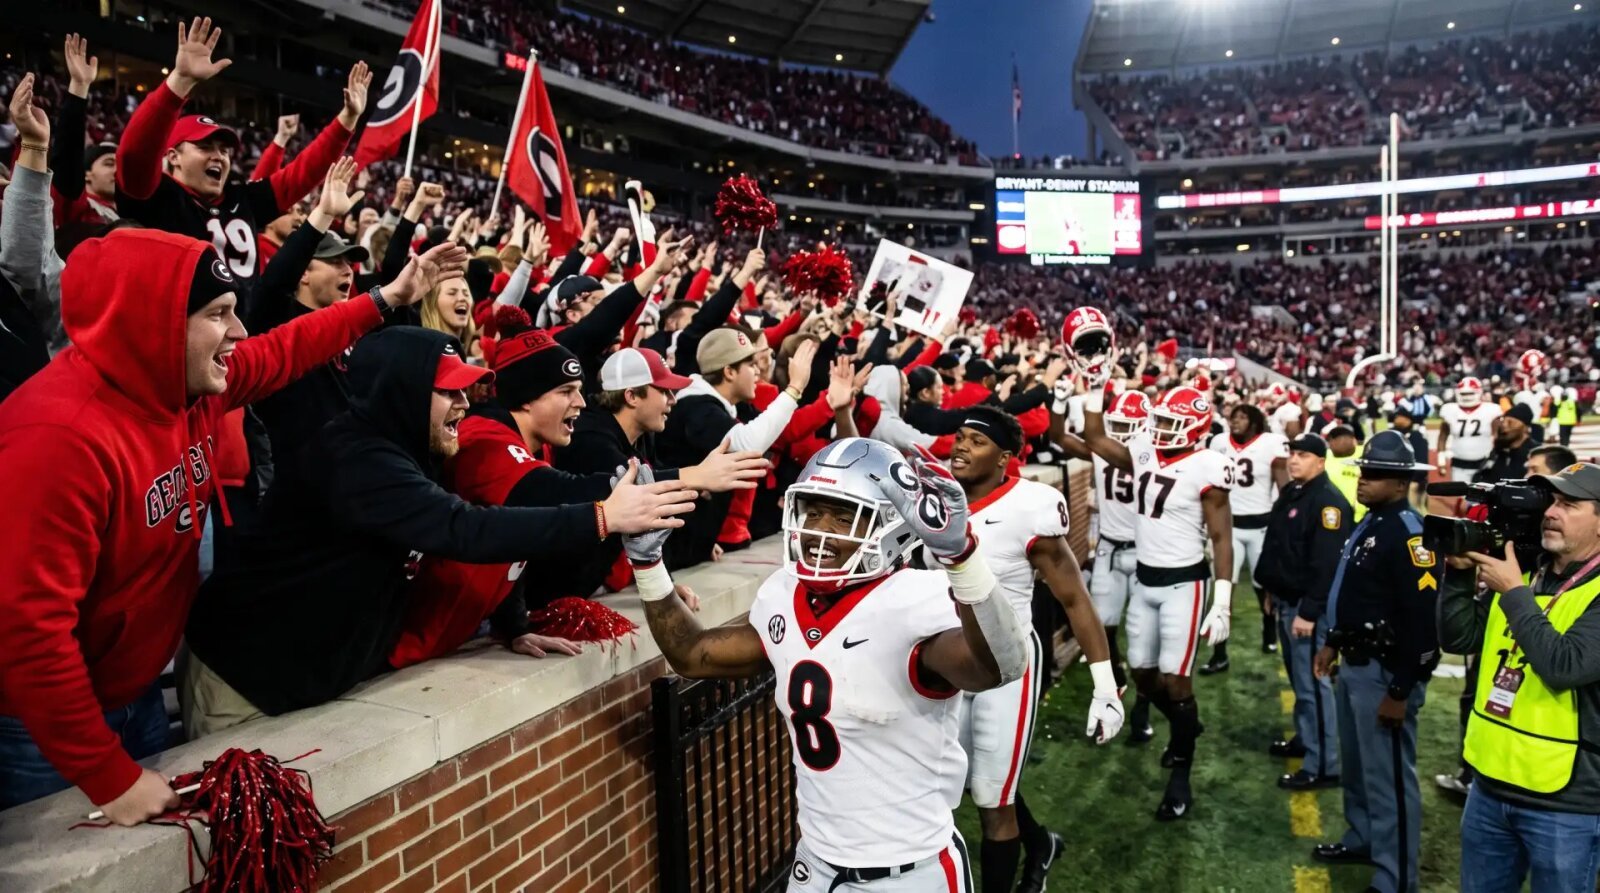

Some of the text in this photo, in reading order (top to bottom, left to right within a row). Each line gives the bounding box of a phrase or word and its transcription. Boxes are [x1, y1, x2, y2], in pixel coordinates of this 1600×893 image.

[996, 177, 1140, 193] BRYANT-DENNY STADIUM
[206, 218, 257, 278] 19
[1457, 419, 1482, 438] 72
[1103, 464, 1134, 504] 15
[1138, 471, 1176, 519] 17
[1057, 501, 1068, 528] 8
[806, 628, 821, 640] G
[788, 660, 841, 772] 8
[792, 860, 810, 882] G
